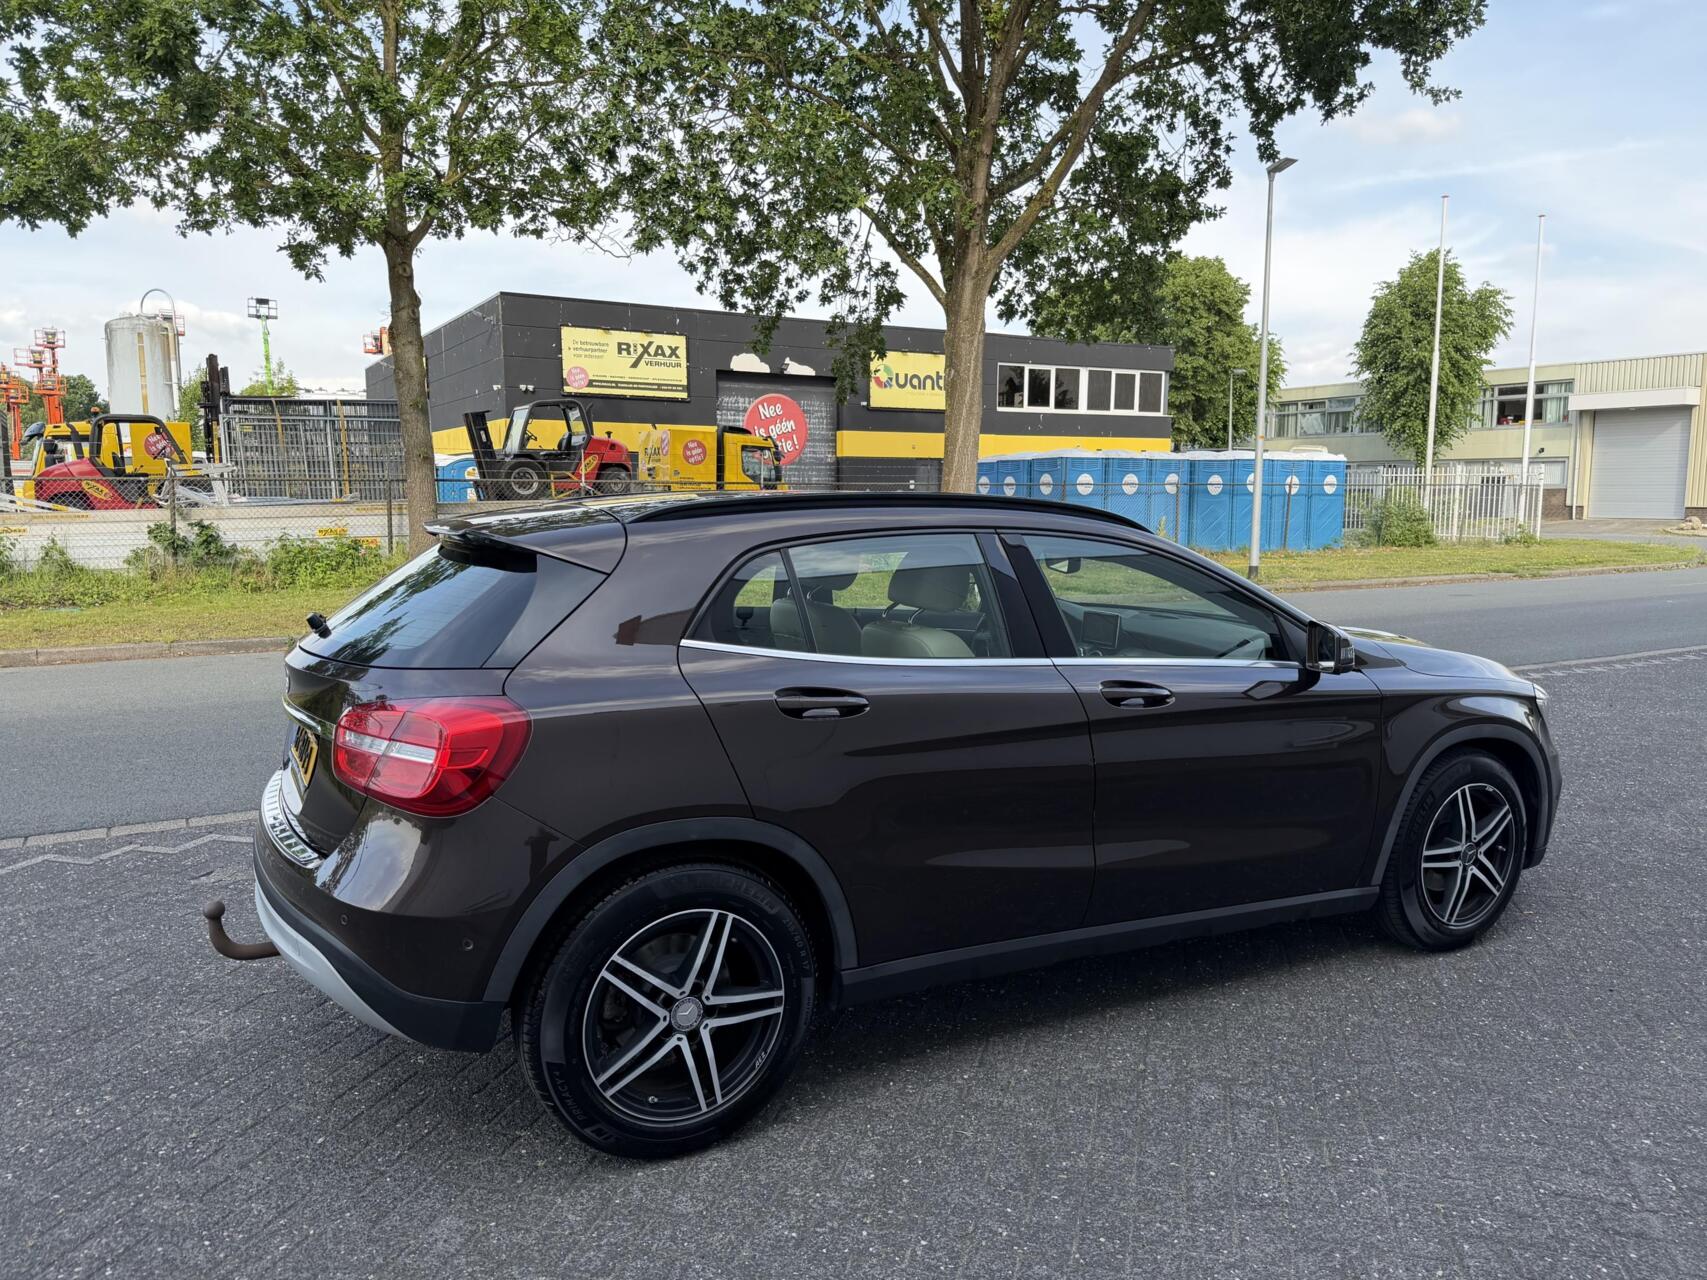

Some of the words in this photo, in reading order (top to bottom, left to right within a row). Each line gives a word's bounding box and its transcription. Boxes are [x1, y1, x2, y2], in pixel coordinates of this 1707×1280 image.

[644, 360, 682, 368] VERHUUR
[758, 402, 783, 419] Nee
[754, 425, 767, 437] is
[769, 418, 796, 439] géén
